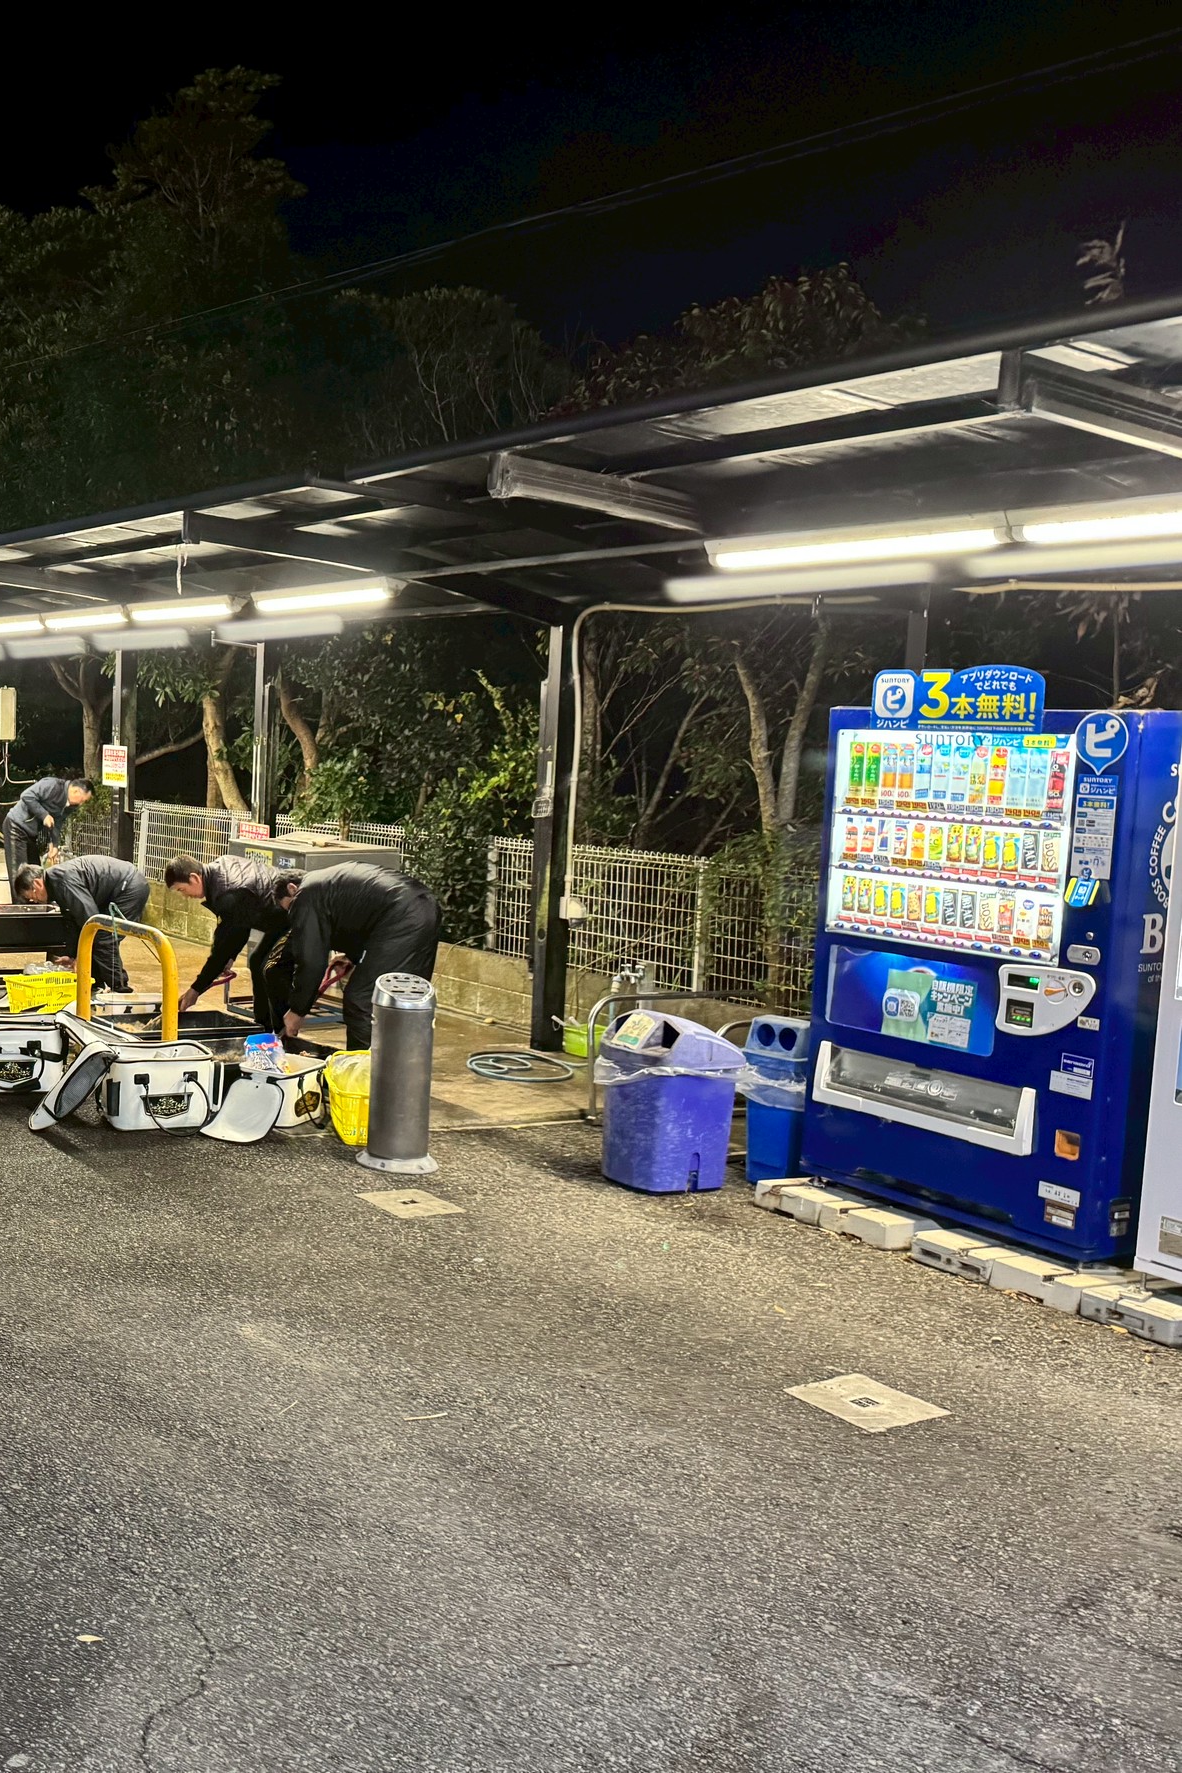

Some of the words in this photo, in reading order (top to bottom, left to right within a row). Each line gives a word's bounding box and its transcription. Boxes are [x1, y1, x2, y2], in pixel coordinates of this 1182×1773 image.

[960, 669, 1034, 684] アプリダウンロード
[974, 680, 1017, 691] でどれでも
[919, 672, 1037, 721] 3本無料!
[876, 719, 910, 729] ジハンピ
[1085, 718, 1120, 758] ピ
[1170, 763, 1179, 777] S
[1083, 776, 1113, 784] SUNTORY
[1090, 786, 1116, 796] ジハンピ
[1044, 842, 1057, 871] BOSS
[1149, 824, 1167, 876] COFFEE
[981, 902, 993, 930] BOSS
[1139, 913, 1164, 954] B
[1137, 962, 1163, 973] SUNTO
[931, 979, 974, 997] 自販機限定
[930, 989, 973, 1008] キャンペーン
